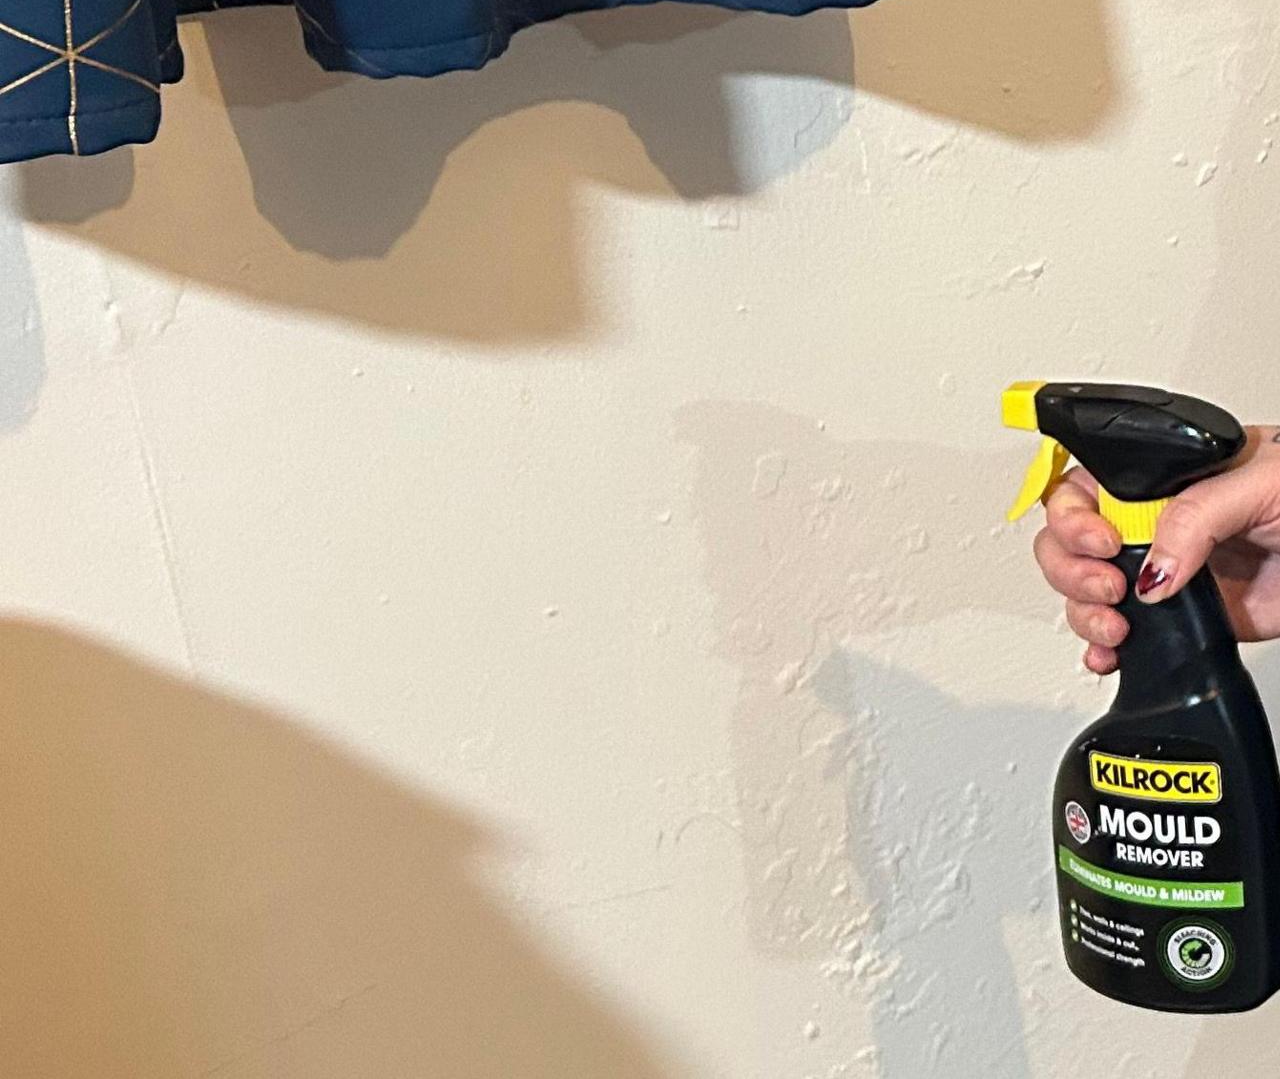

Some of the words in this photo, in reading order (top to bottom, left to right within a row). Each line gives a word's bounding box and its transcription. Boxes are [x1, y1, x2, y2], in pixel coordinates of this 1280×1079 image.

[1095, 760, 1214, 795] KILROCK
[1099, 804, 1221, 846] MOULD
[1116, 842, 1204, 868] REMOVER
[1114, 880, 1157, 899] MOULD
[1159, 888, 1169, 900] &
[1172, 889, 1225, 902] MILDEW
